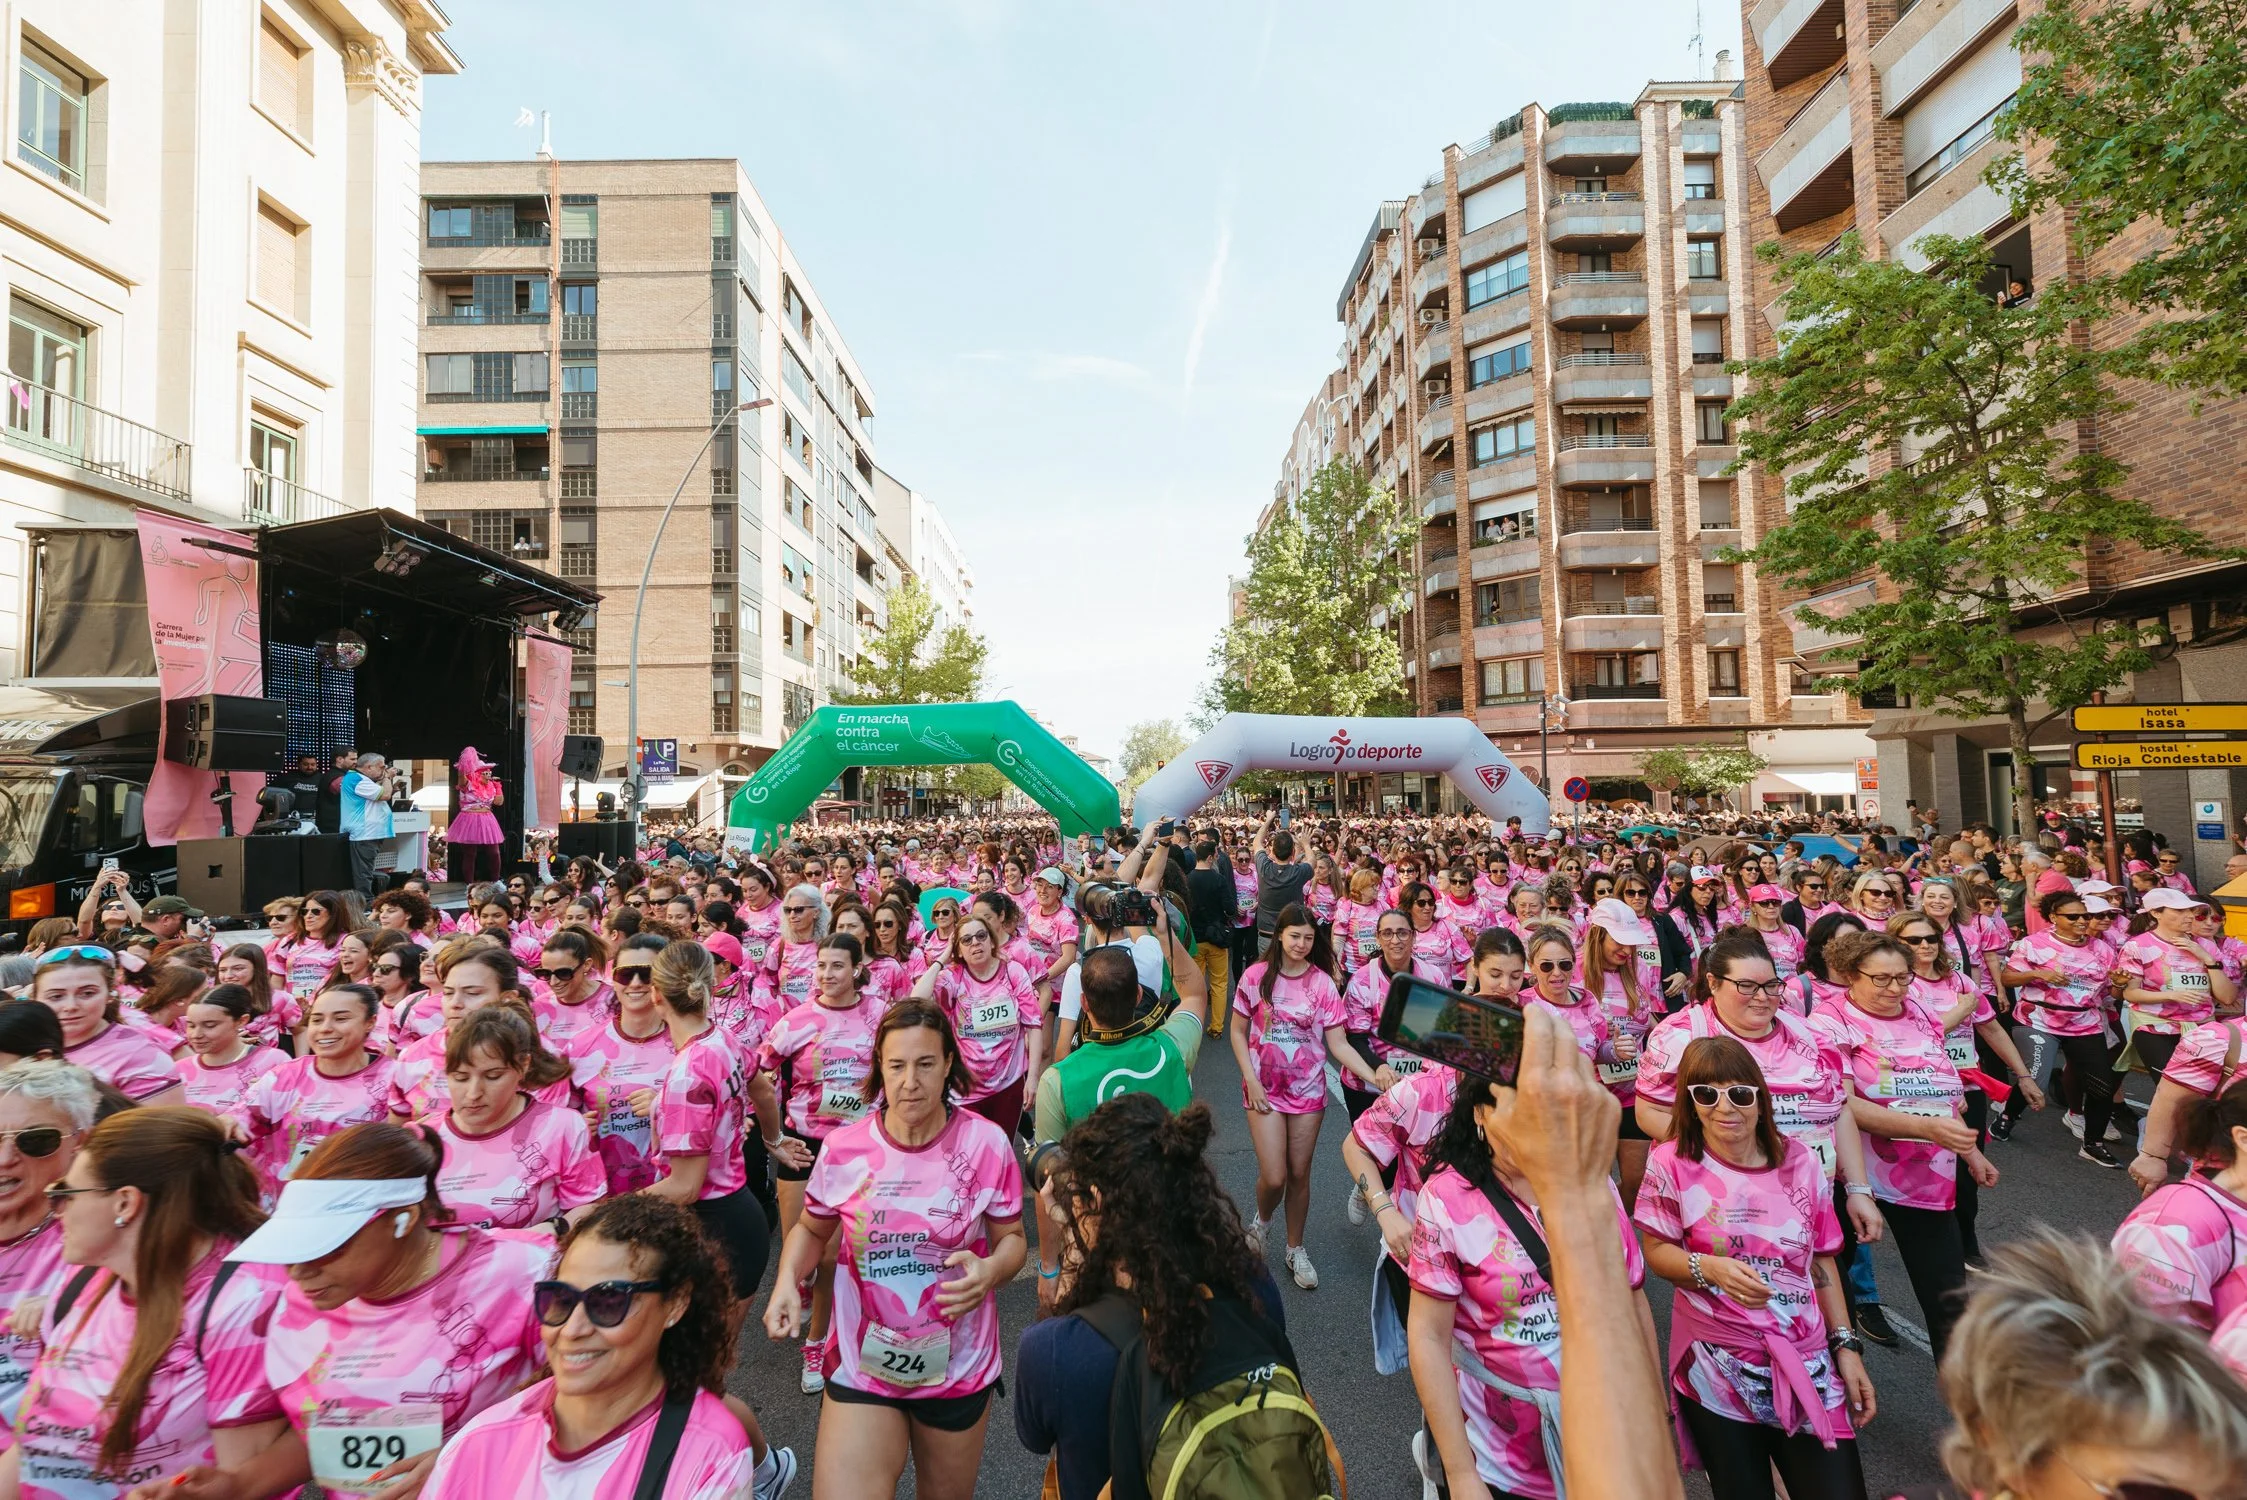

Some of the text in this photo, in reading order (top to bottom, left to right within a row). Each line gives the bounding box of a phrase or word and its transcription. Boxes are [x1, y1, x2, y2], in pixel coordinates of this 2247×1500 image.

[156, 621, 183, 631] Carrera
[175, 632, 196, 641] Mujer
[837, 713, 909, 724] En marcha
[2146, 708, 2178, 716] hotel
[2140, 717, 2185, 728] Isasa
[836, 726, 880, 738] contra
[663, 741, 675, 758] P
[836, 740, 899, 752] el cáncer
[1357, 743, 1423, 761] deporte
[2140, 744, 2178, 752] hostal
[2092, 752, 2242, 766] Rioja Condestable
[785, 763, 802, 776] Rioja
[1024, 758, 1076, 808] asociación española
[1031, 783, 1046, 798] Rioja
[2180, 974, 2208, 985] 8178
[979, 1004, 1009, 1022] 3975
[964, 1027, 1017, 1038] Investigación
[1100, 1032, 1123, 1040] Nikon
[822, 1056, 858, 1066] Carrera
[823, 1069, 838, 1078] por
[1892, 1064, 1935, 1075] Carrera
[1894, 1075, 1930, 1087] por la
[829, 1093, 863, 1112] 4796
[1770, 1091, 1808, 1102] rrera
[610, 1112, 629, 1122] por
[611, 1119, 651, 1133] Investig
[870, 1210, 886, 1225] XI
[868, 1230, 927, 1244] Carrera
[1728, 1235, 1744, 1249] XI
[868, 1246, 911, 1264] por la
[869, 1260, 956, 1279] Investigac
[1519, 1272, 1534, 1290] XI
[1520, 1290, 1556, 1307] Carre
[1523, 1313, 1546, 1327] por
[881, 1350, 926, 1374] 224
[341, 1434, 406, 1469] 829
